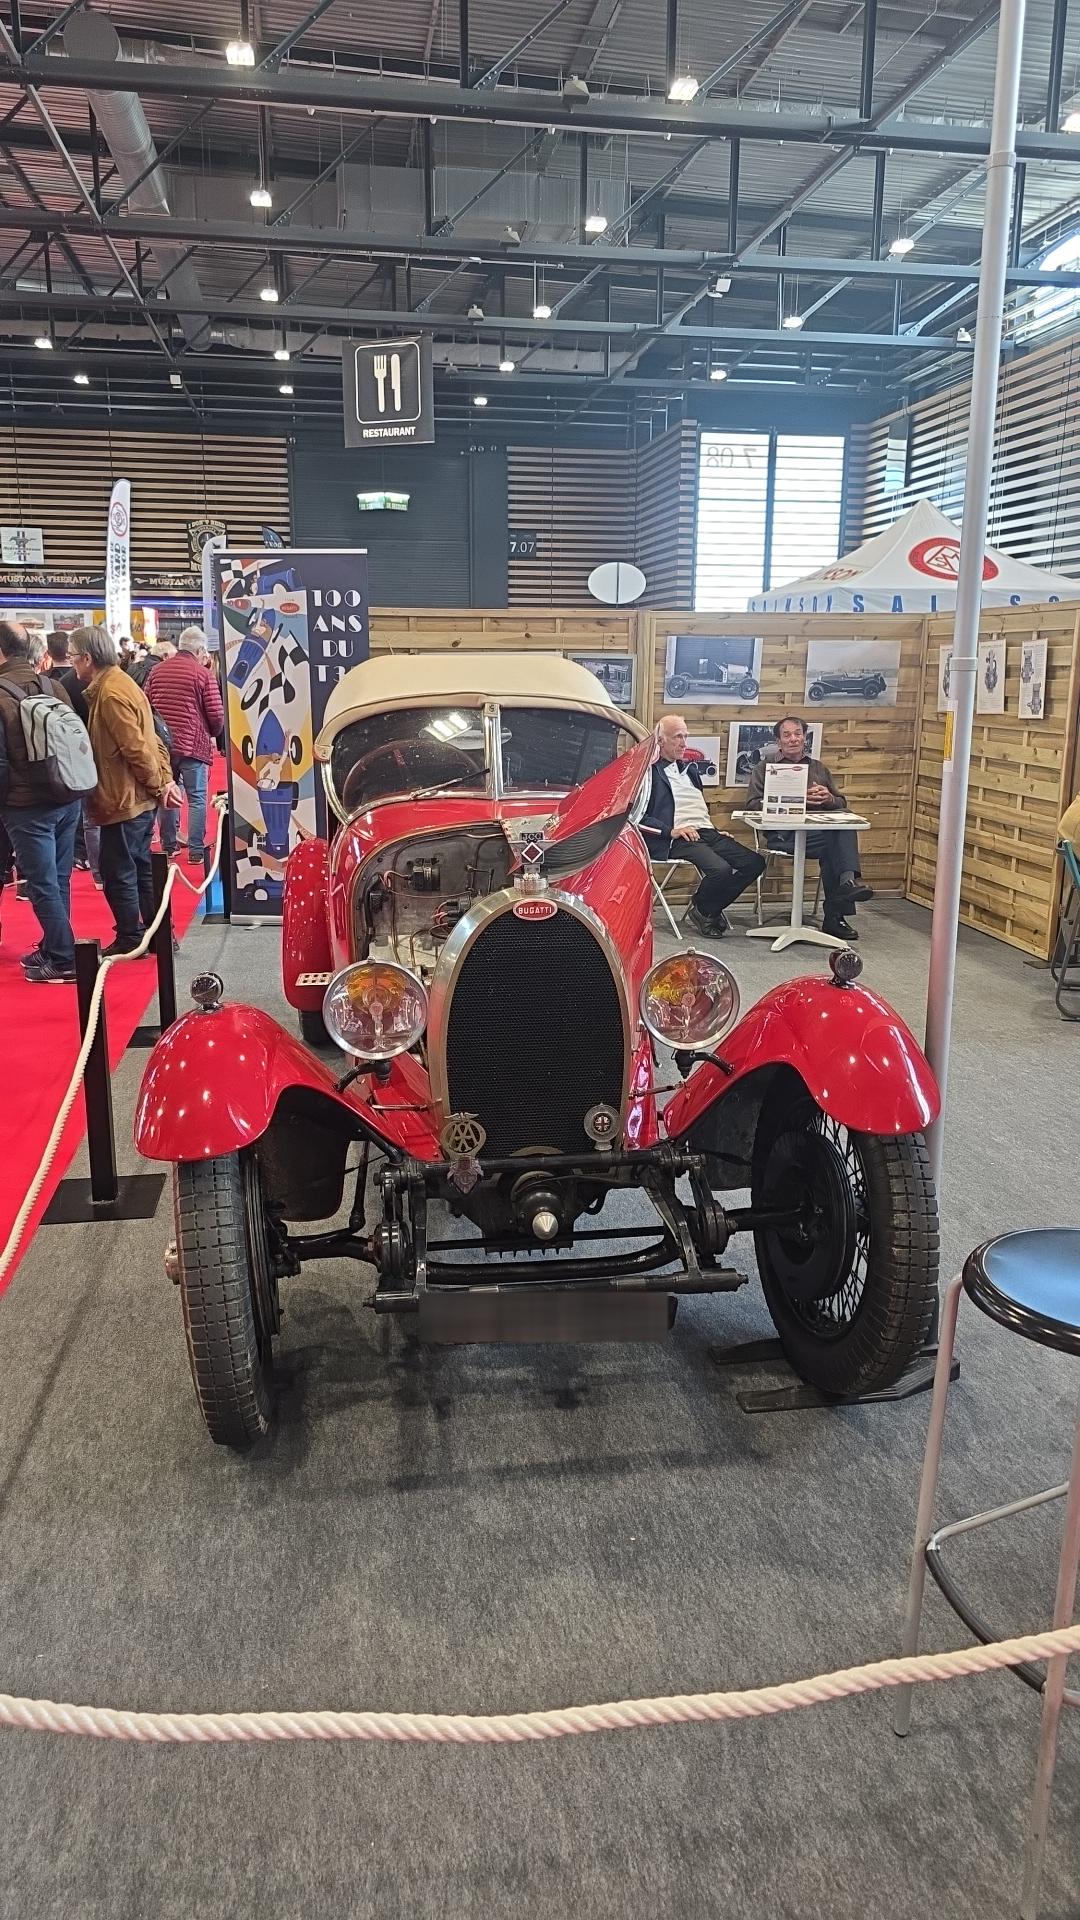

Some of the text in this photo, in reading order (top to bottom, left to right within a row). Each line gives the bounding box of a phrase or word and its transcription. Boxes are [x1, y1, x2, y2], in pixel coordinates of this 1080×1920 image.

[362, 426, 416, 438] RESTAURANT
[509, 541, 535, 553] 7.07
[310, 589, 361, 607] 100
[312, 614, 363, 633] ANS
[322, 639, 354, 657] DU
[314, 664, 354, 682] T3
[518, 906, 552, 915] BUGATTI
